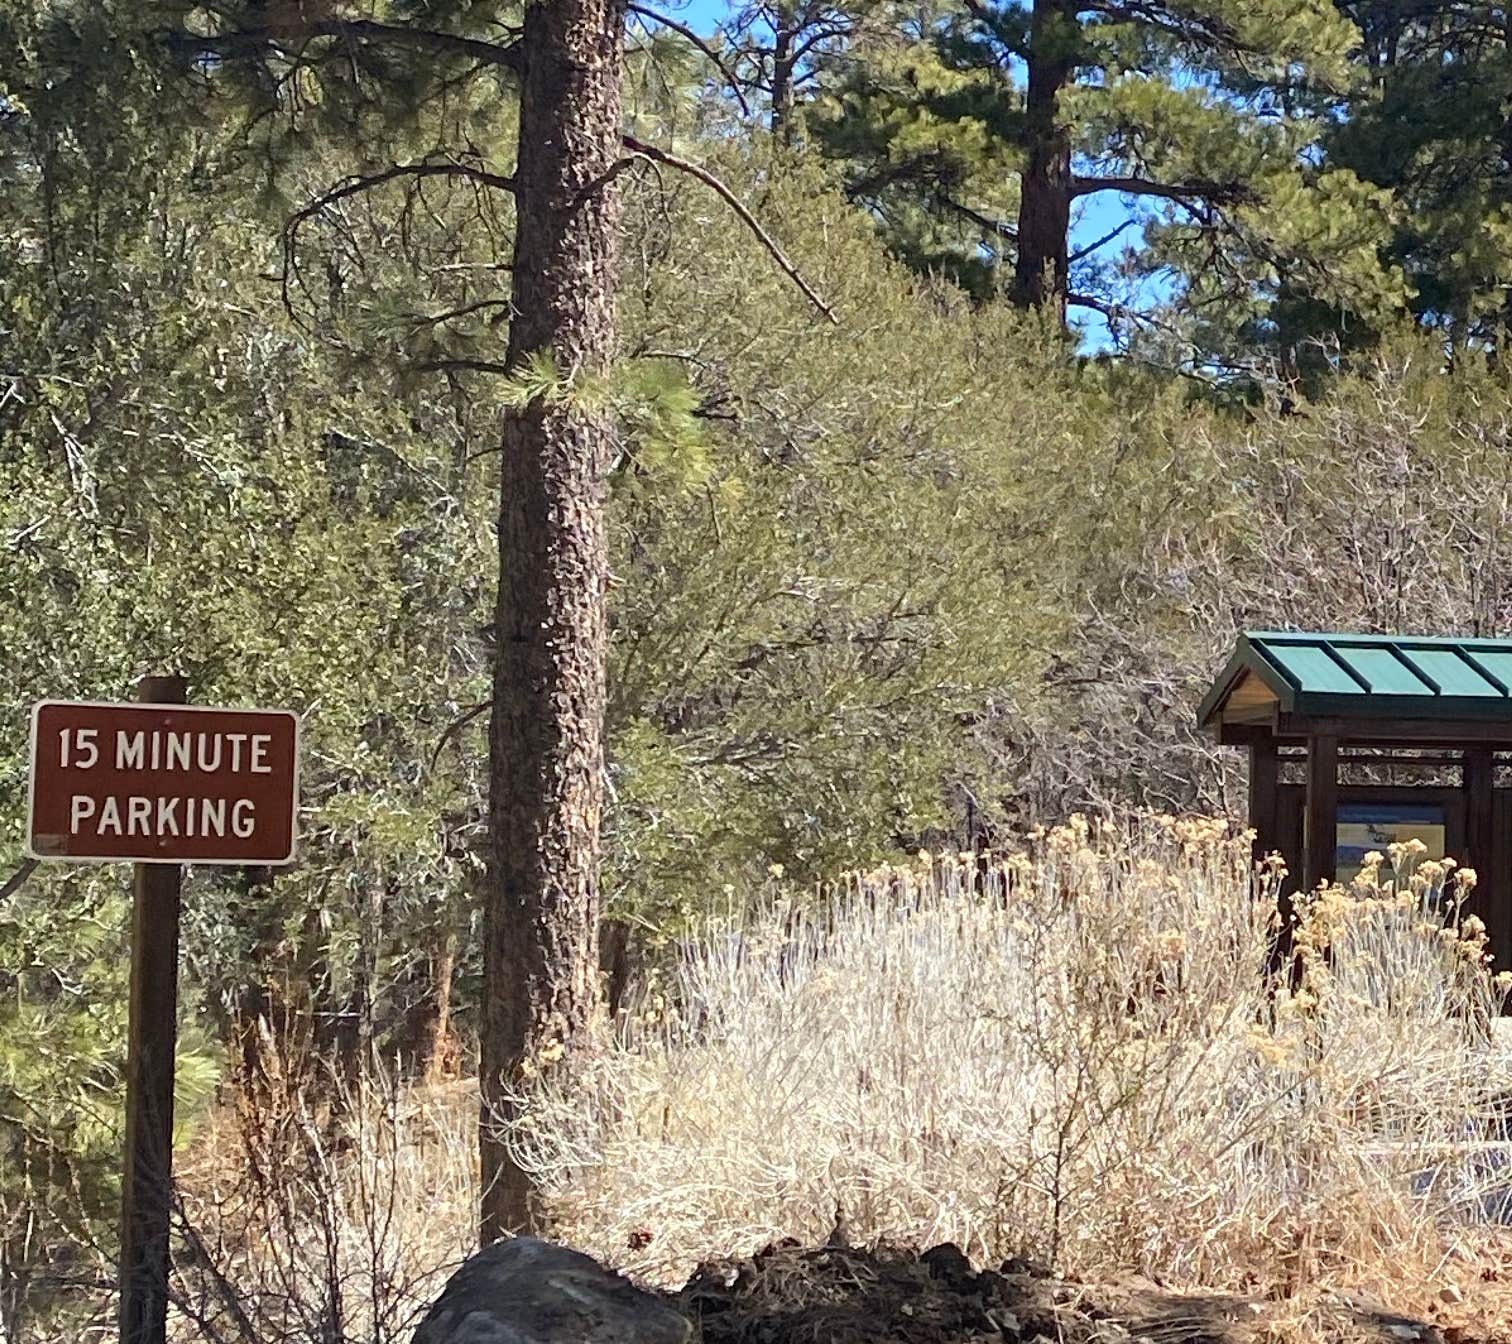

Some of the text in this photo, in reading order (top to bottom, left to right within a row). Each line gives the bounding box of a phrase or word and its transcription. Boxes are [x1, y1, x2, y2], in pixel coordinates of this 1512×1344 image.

[59, 728, 272, 773] 15 MINUTE
[70, 795, 256, 838] PARKING
